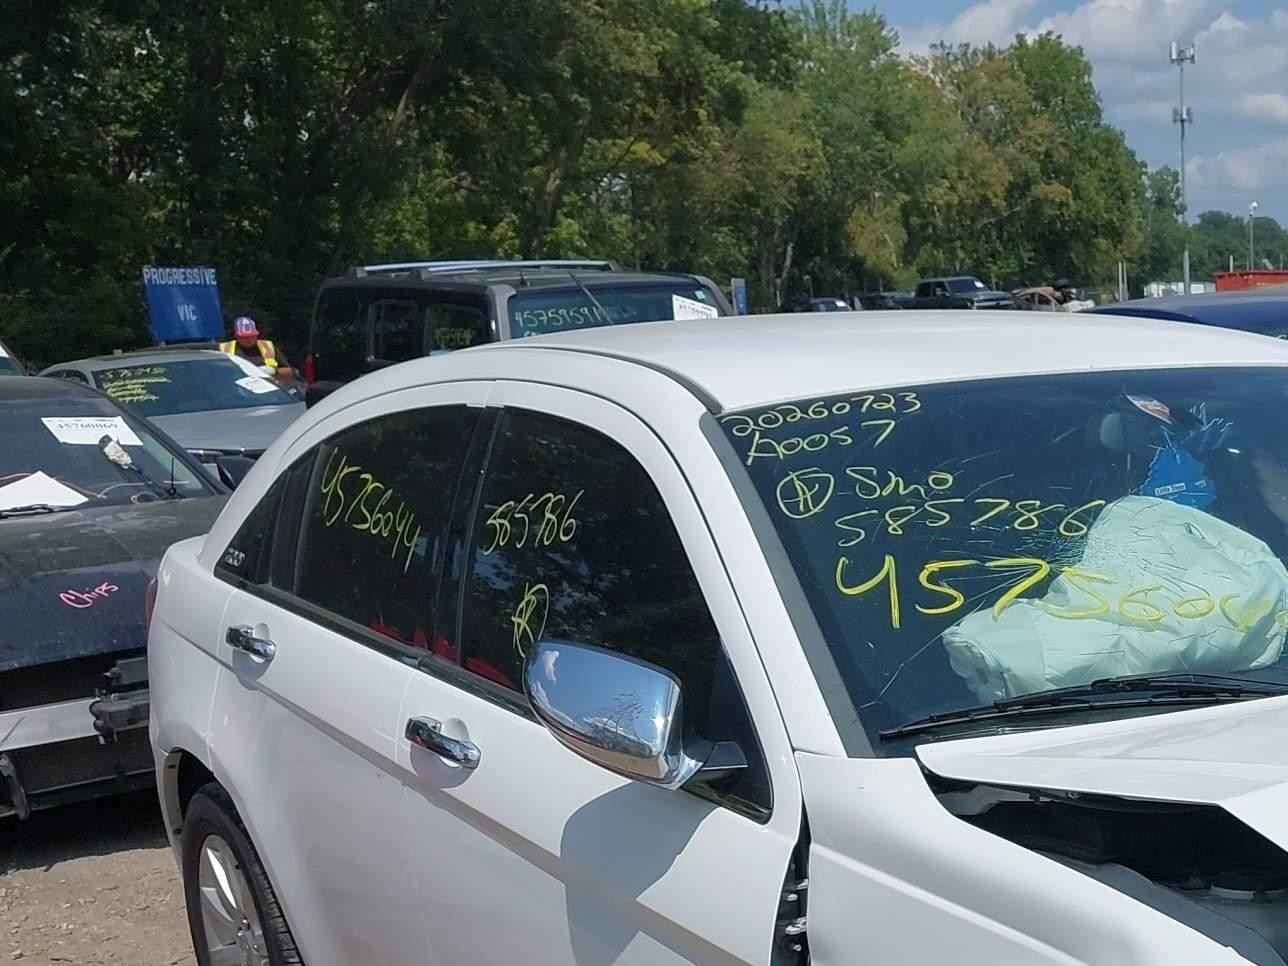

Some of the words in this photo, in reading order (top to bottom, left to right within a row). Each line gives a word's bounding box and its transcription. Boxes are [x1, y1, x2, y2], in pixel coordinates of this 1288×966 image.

[143, 266, 217, 285] PROGRESSIVE
[177, 304, 197, 321] VIC
[721, 392, 922, 437] 20260723
[834, 499, 1106, 547] 585786
